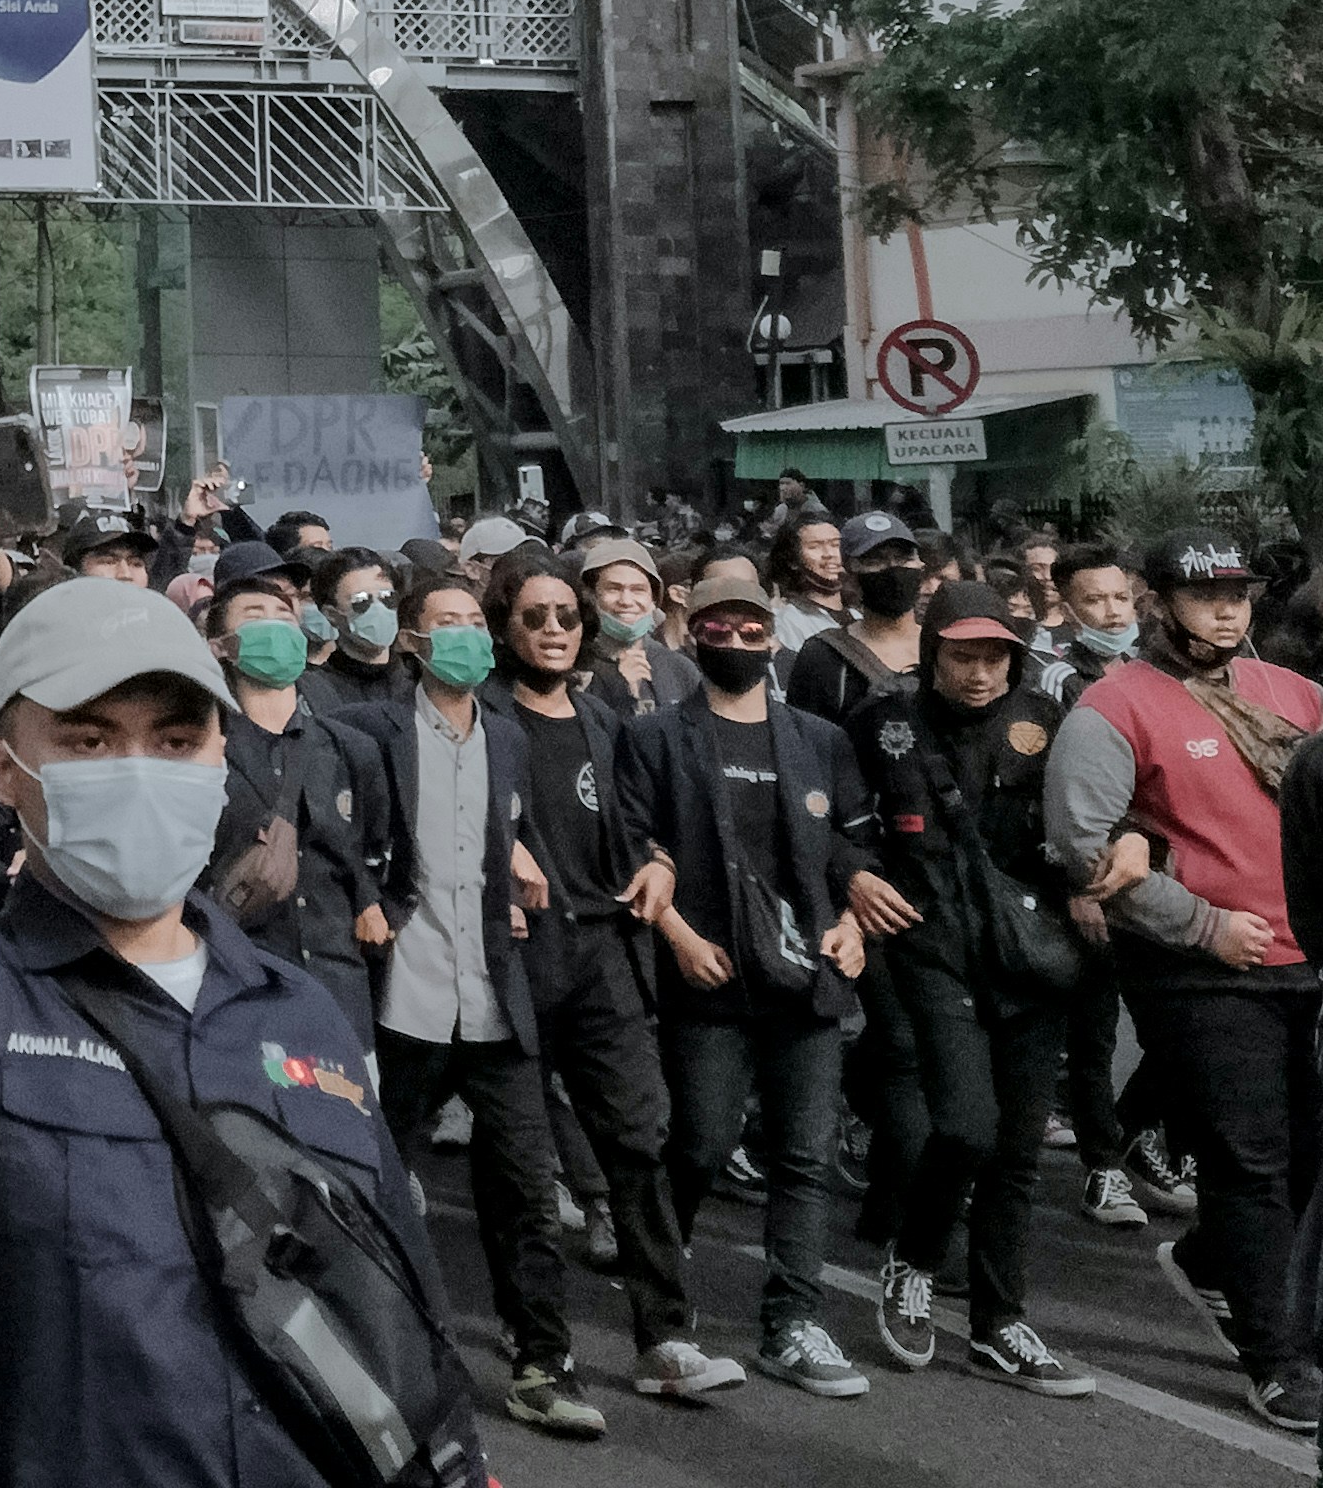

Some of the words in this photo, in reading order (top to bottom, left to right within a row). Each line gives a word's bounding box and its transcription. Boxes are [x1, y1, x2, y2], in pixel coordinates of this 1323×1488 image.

[0, 0, 21, 13] Sisi
[24, 0, 59, 14] Anda
[41, 392, 66, 409] MIA
[897, 426, 971, 441] KECUALI
[893, 443, 979, 458] UPACARA
